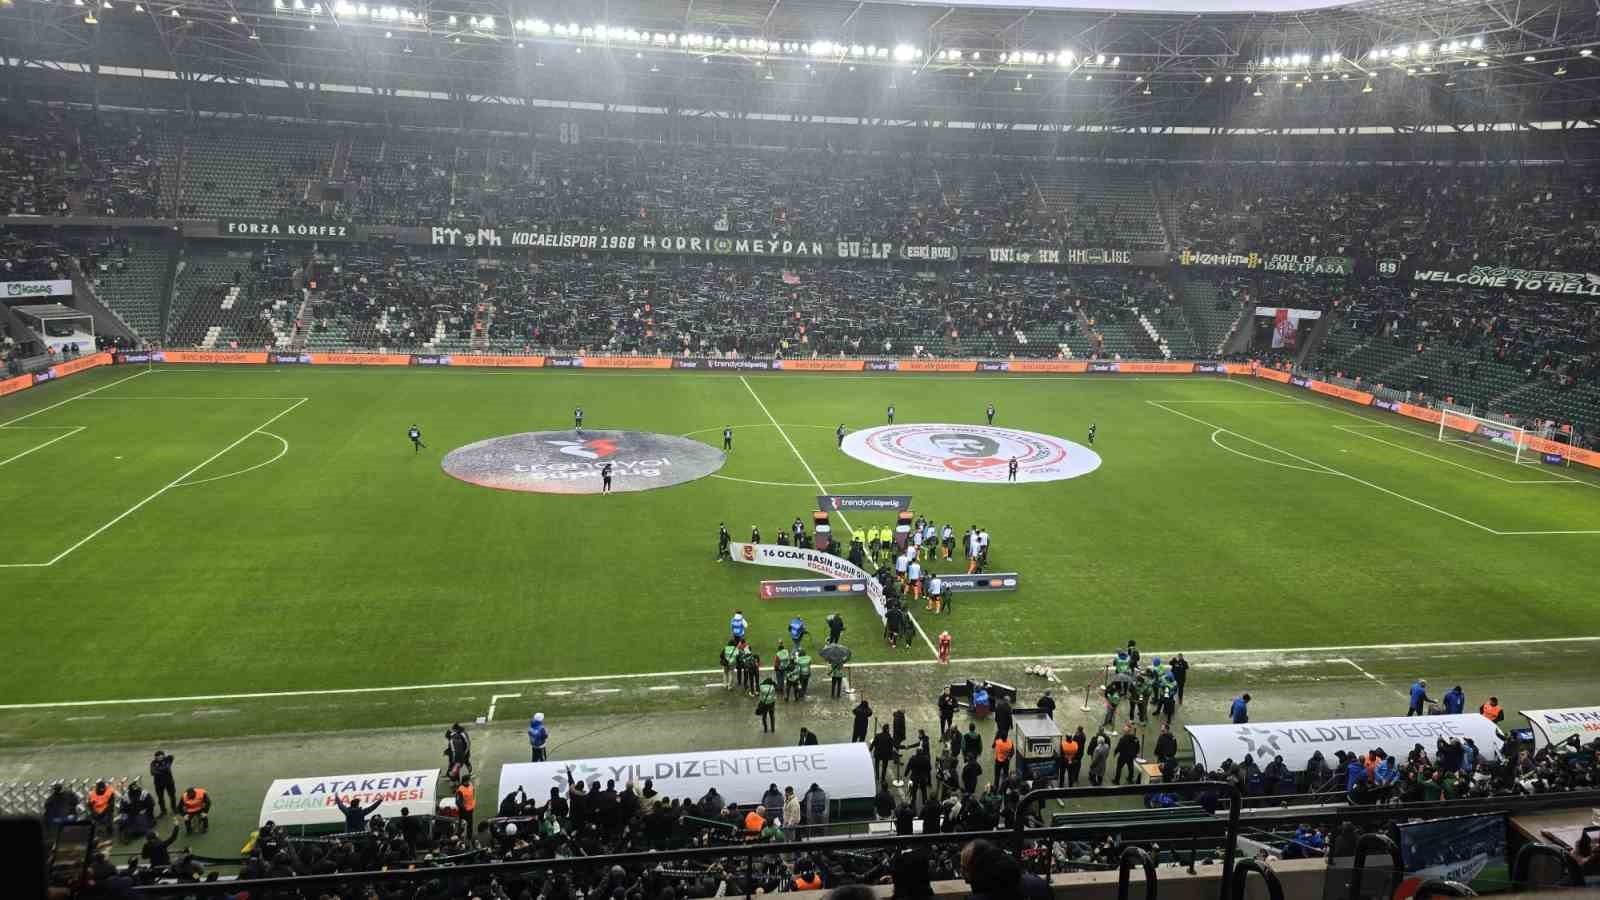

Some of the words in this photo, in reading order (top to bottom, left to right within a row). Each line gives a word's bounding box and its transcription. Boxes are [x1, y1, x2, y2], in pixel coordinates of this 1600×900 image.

[228, 222, 280, 234] FORZA
[511, 231, 598, 248] KOCAELİSPOR
[600, 235, 636, 249] 1966
[735, 238, 824, 255] MEYDAN
[1379, 262, 1397, 274] 89
[1413, 270, 1508, 288] WELCOME
[1510, 278, 1542, 291] TO
[763, 549, 775, 557] 16
[778, 550, 805, 561] OCAK
[807, 553, 833, 568] BASIN
[310, 775, 428, 795] ATAKENT
